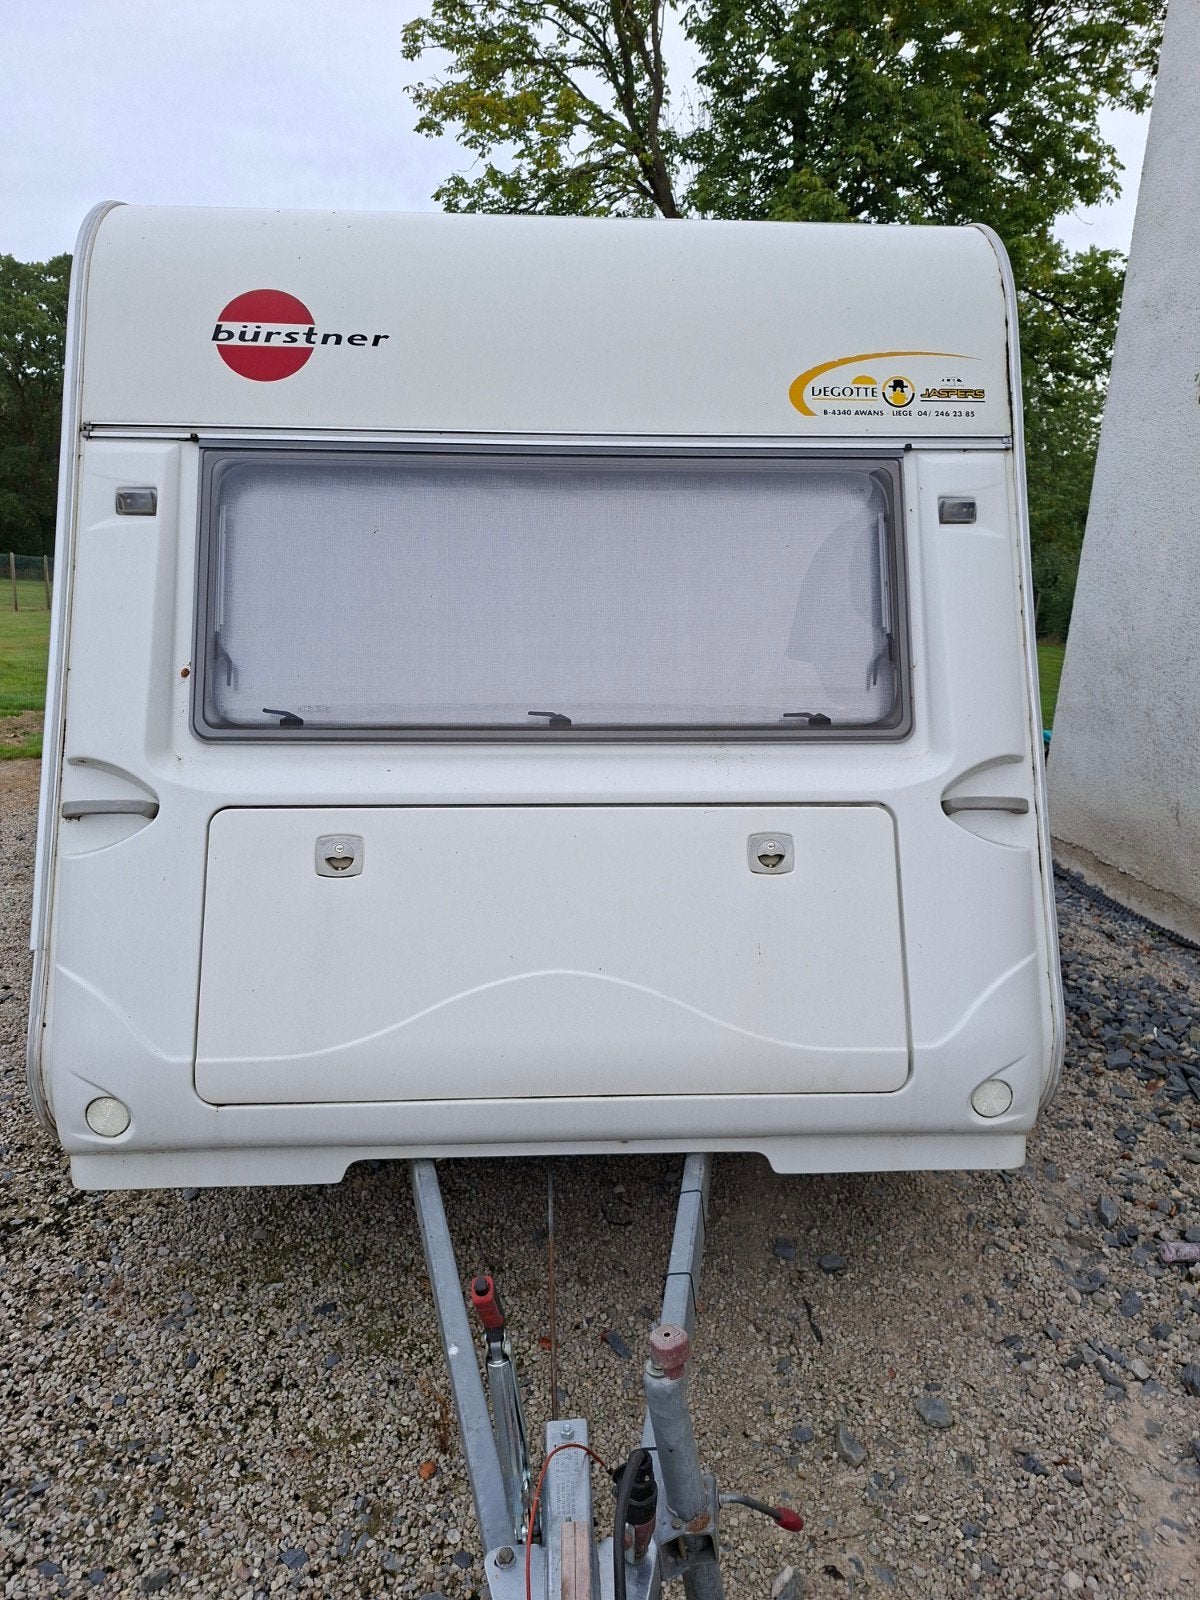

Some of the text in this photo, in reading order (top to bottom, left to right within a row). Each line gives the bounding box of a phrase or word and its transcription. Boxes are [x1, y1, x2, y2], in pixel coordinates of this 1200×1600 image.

[211, 324, 390, 347] bürstner
[812, 386, 878, 397] DEGOTTE
[921, 388, 985, 399] JASPERS
[854, 409, 884, 417] AWANS
[917, 410, 932, 418] 04/
[952, 410, 963, 418] 23
[965, 410, 975, 418] 85
